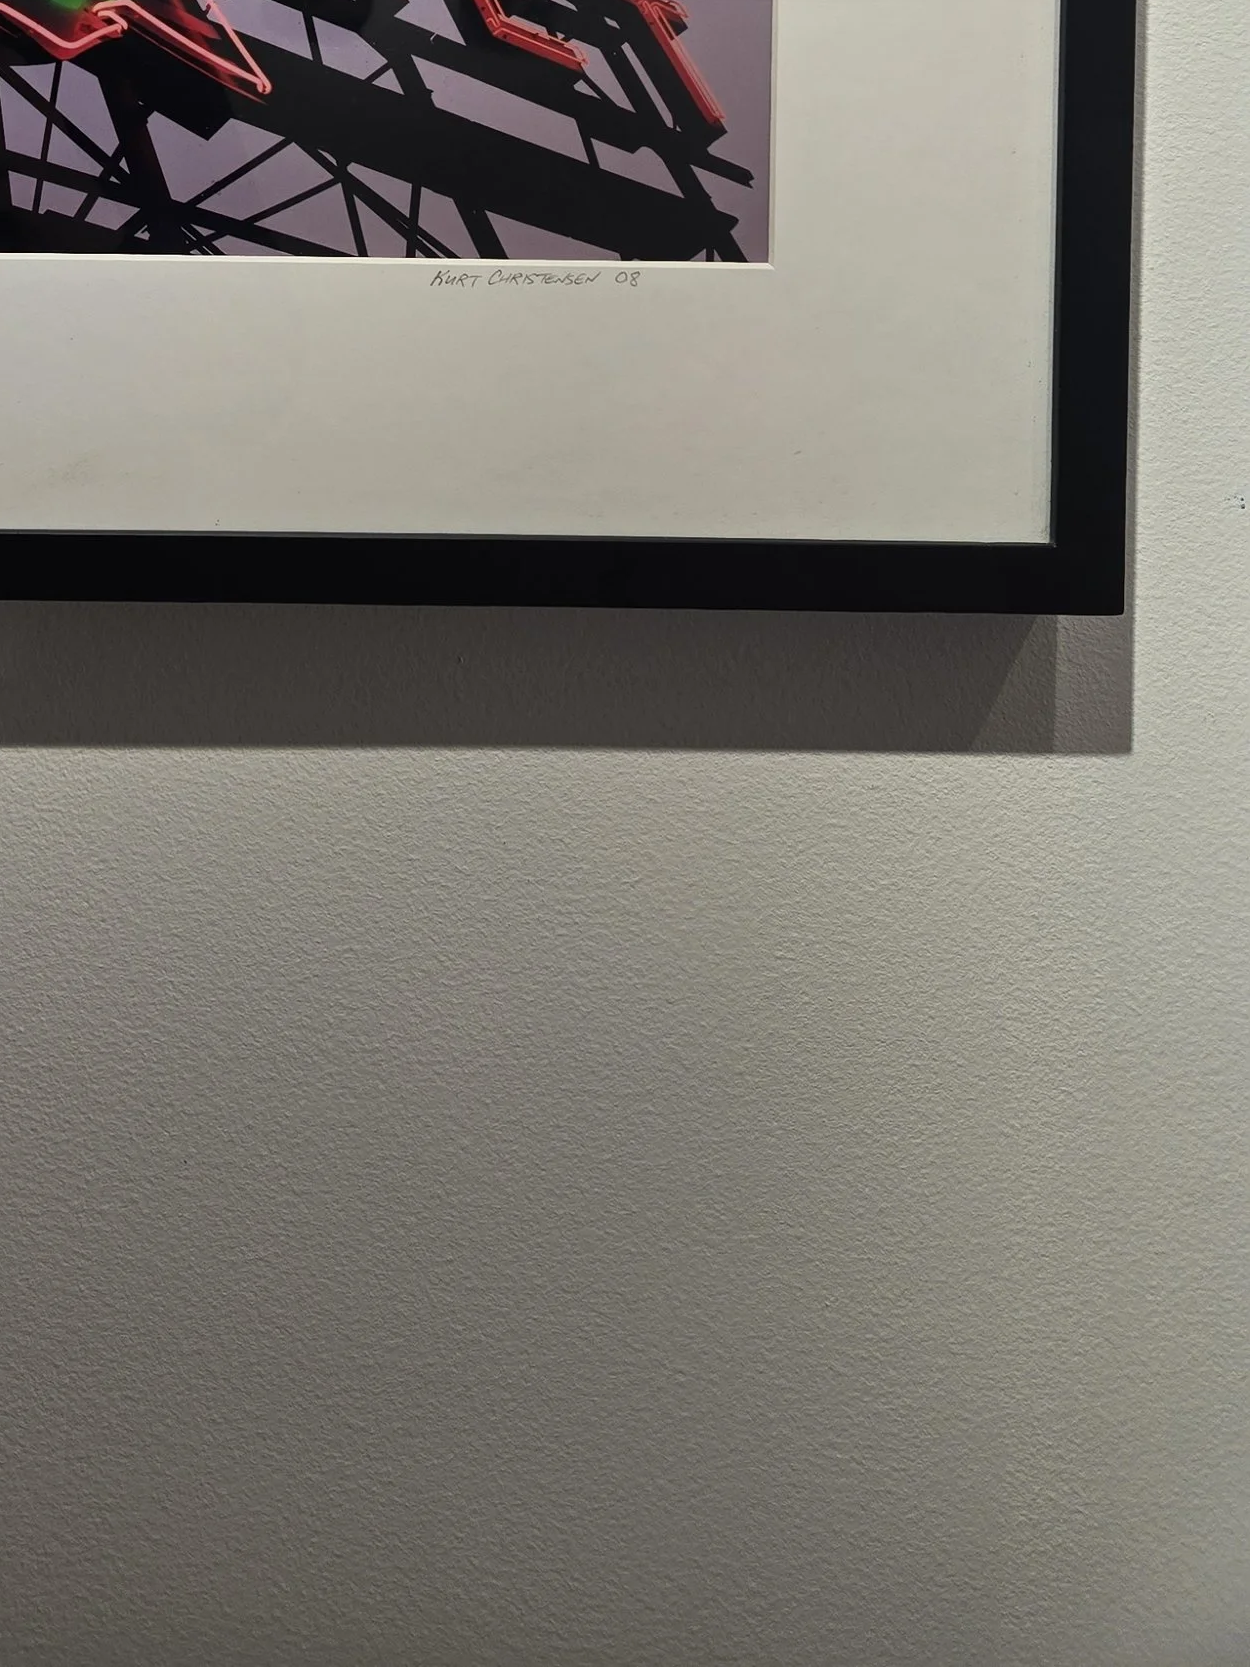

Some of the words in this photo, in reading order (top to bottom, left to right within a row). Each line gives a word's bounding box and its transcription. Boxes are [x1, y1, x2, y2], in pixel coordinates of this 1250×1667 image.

[429, 269, 483, 287] KURT
[487, 269, 602, 286] CHRISTENSEN
[614, 270, 642, 287] 08
